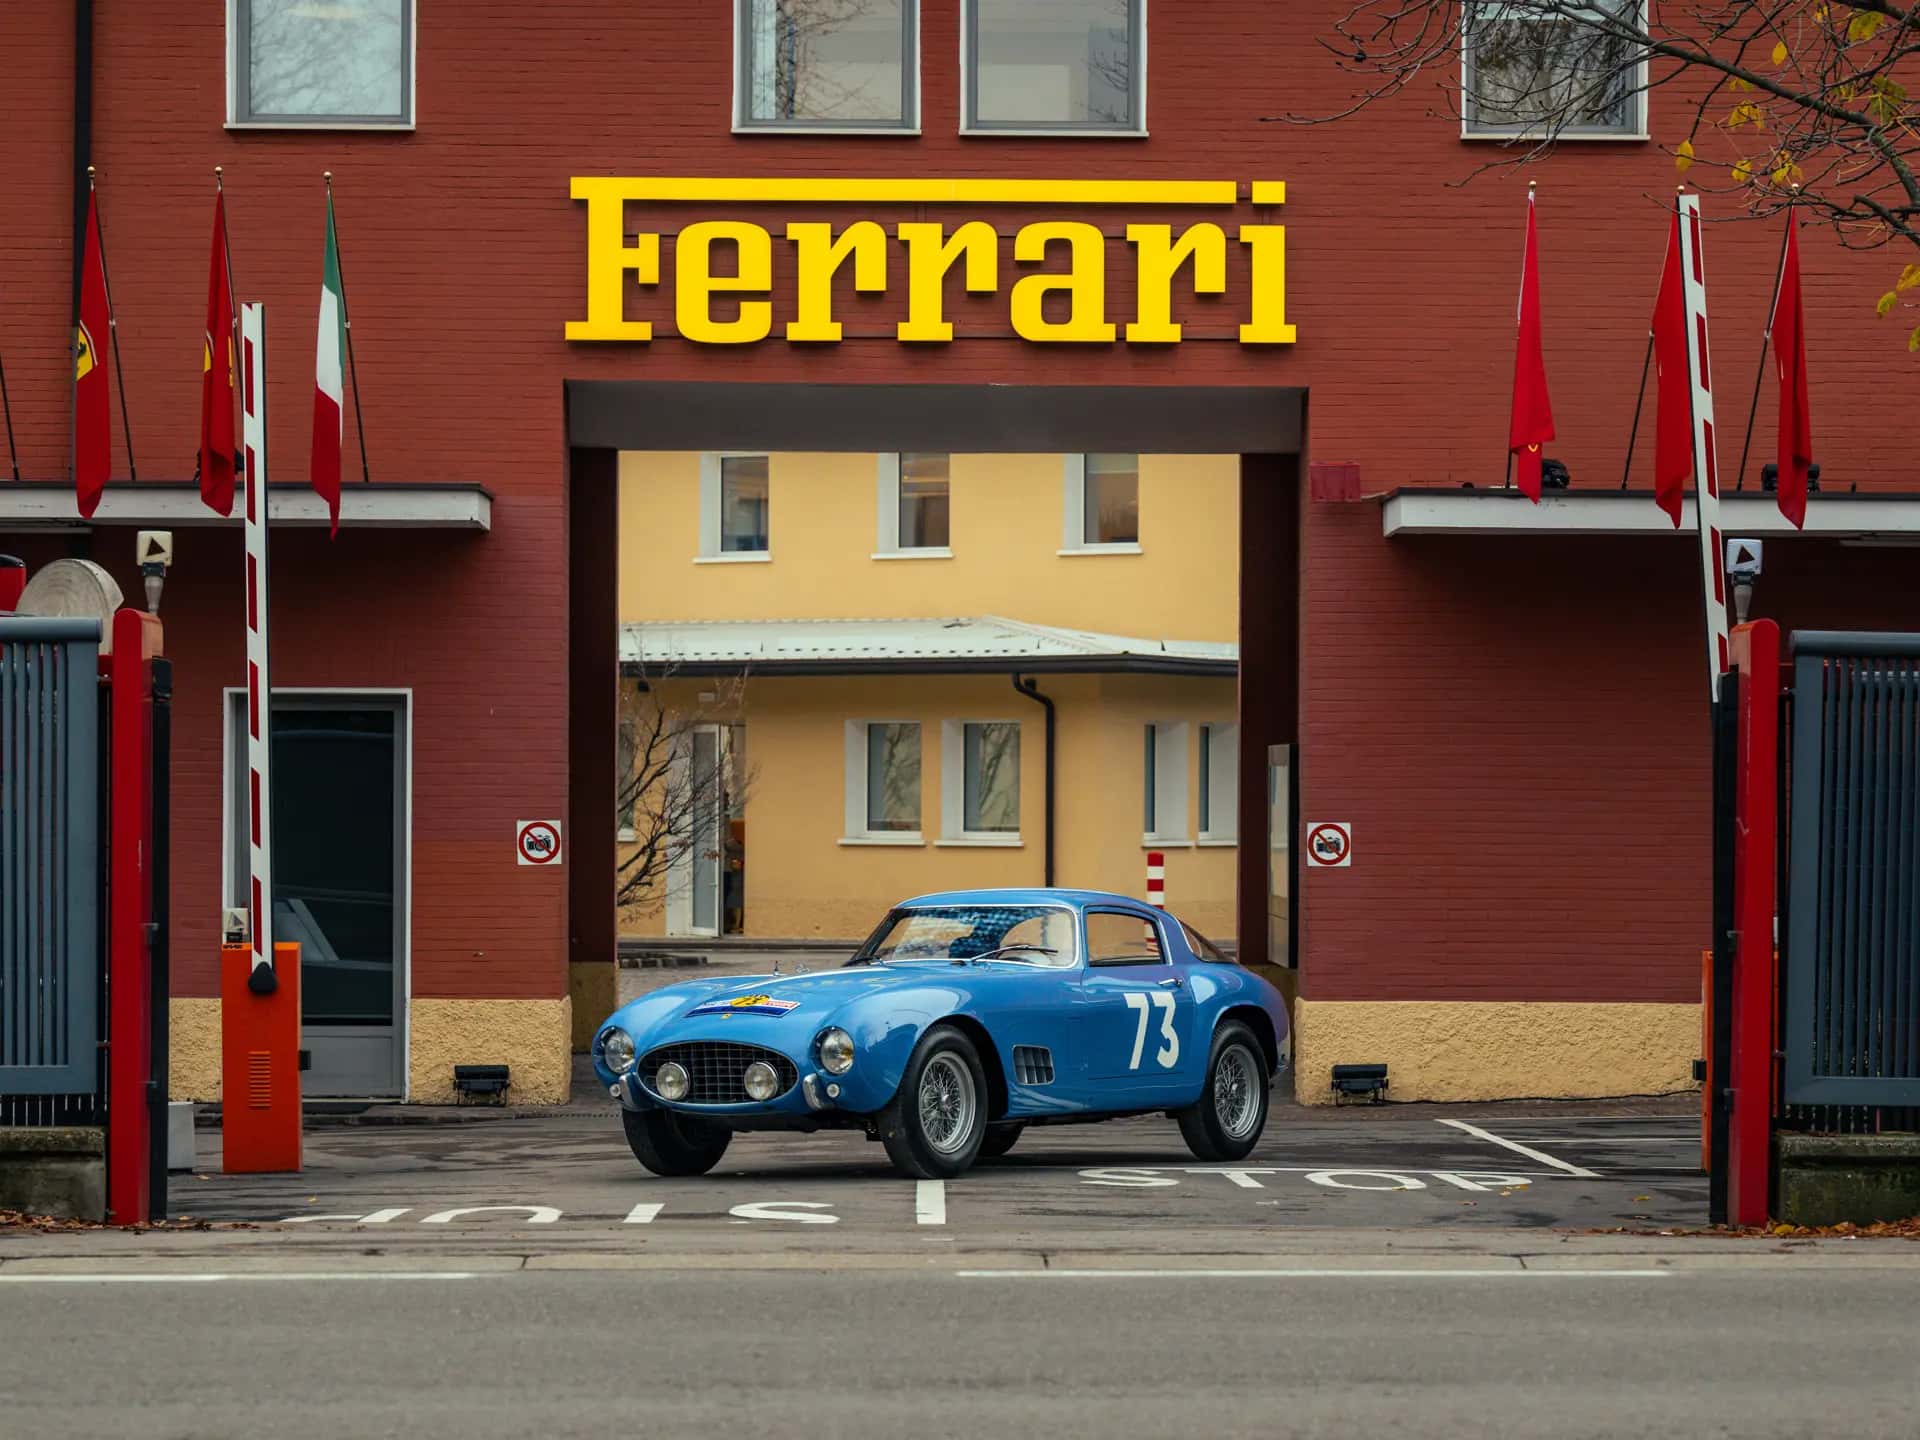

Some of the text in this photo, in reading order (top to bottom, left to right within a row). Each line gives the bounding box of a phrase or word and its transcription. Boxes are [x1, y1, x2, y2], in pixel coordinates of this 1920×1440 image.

[565, 176, 1296, 344] Ferrari
[1123, 992, 1179, 1070] 73
[1077, 1168, 1533, 1192] STOP
